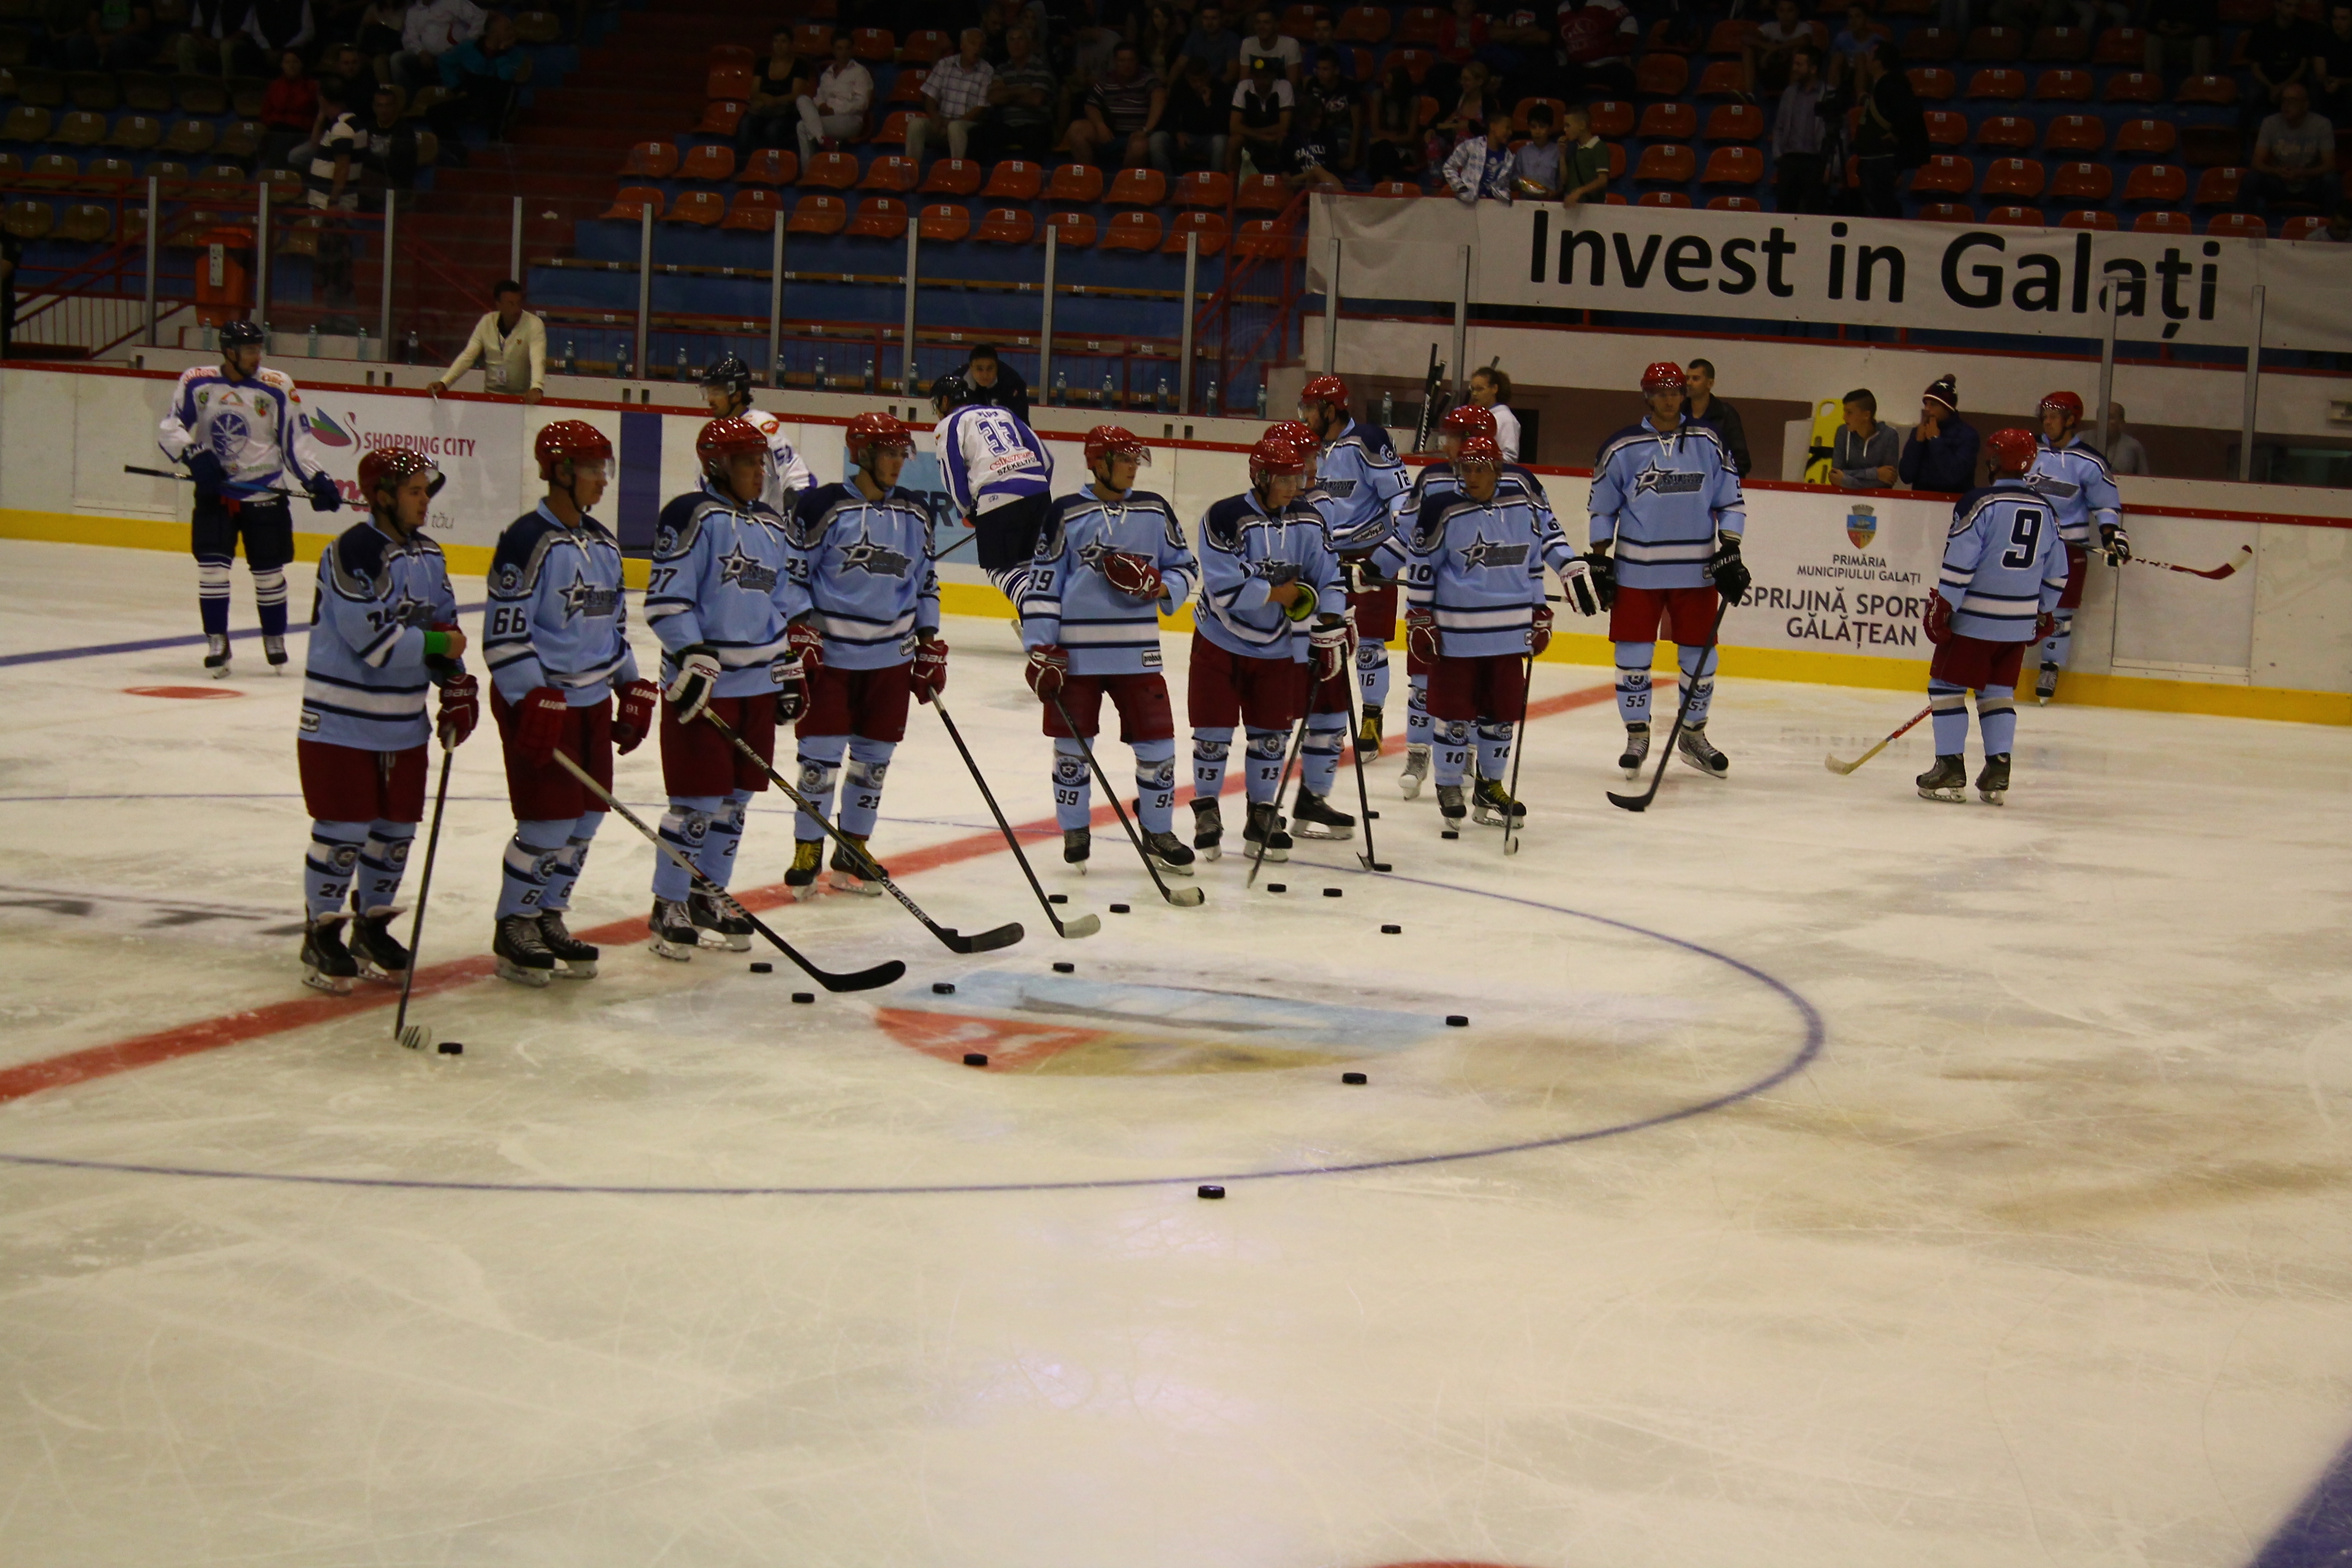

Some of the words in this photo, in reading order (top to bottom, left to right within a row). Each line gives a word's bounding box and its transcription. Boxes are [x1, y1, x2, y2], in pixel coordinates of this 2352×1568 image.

[1531, 210, 1796, 297] Invest
[1828, 222, 1905, 303] in
[1941, 232, 2220, 339] Galați
[364, 432, 440, 455] SHOPPING
[444, 438, 476, 457] CITY
[976, 419, 1025, 457] 33
[432, 513, 455, 529] tău
[1547, 518, 1560, 531] 6
[2002, 508, 2041, 569] 9
[785, 558, 810, 579] 23
[1832, 554, 1887, 568] PRIMĂRIA
[1409, 563, 1432, 582] 10
[1797, 565, 1875, 581] MUNICIPIULUI
[1879, 570, 1921, 586] GALAȚI
[646, 568, 678, 595] 27
[1740, 586, 1848, 613] SPRIJINĂ
[492, 607, 527, 635] 66
[1787, 613, 1917, 649] GĂLĂȚEAN
[1360, 673, 1375, 687] 16
[1625, 694, 1646, 708] 55
[625, 704, 639, 716] 91
[1410, 715, 1430, 728] 63
[735, 738, 770, 771] BAUER
[1446, 752, 1464, 764] 10
[1197, 767, 1219, 781] 13
[1261, 767, 1279, 780] 13
[1324, 759, 1338, 773] 2
[857, 794, 880, 809] 23
[1057, 789, 1079, 805] 99
[319, 883, 350, 899] 26
[521, 889, 541, 905] 6
[881, 875, 930, 924] SUPREME
